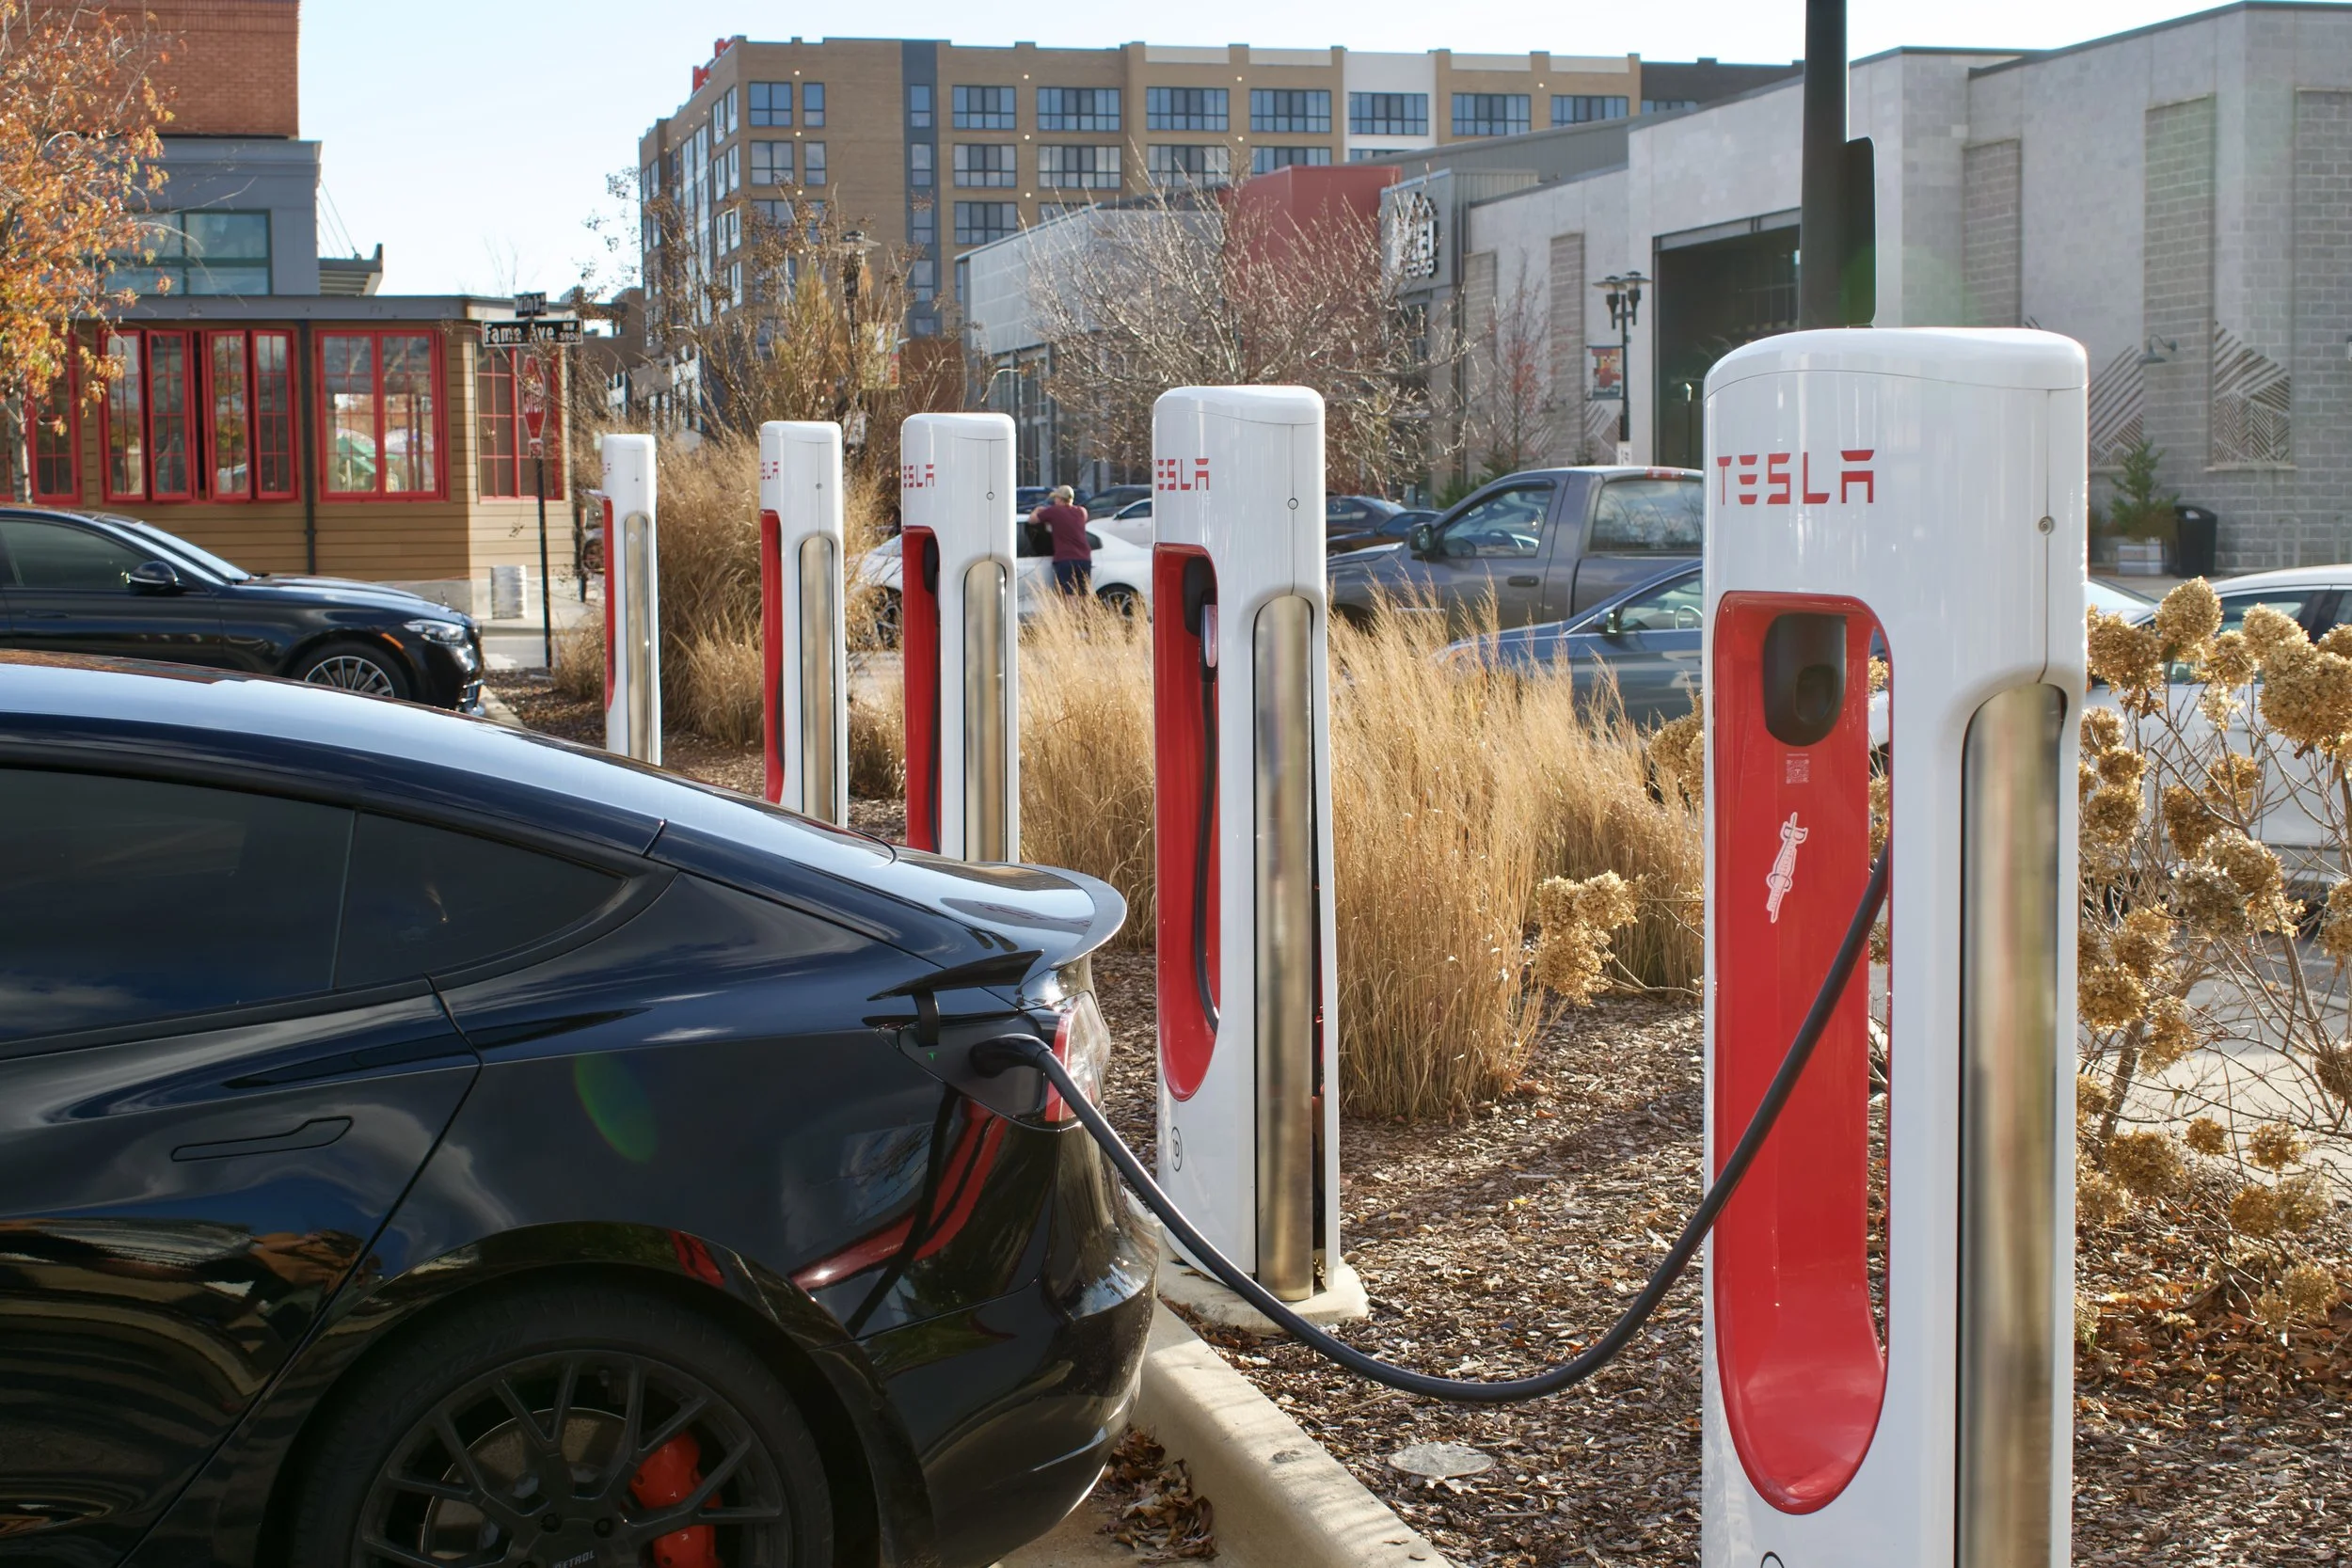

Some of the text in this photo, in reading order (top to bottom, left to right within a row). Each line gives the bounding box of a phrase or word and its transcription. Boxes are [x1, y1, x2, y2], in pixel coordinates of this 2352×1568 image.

[528, 323, 554, 343] Ave
[903, 464, 934, 488] ESLA
[1153, 458, 1209, 490] ESLA
[1717, 450, 1874, 505] TESLA
